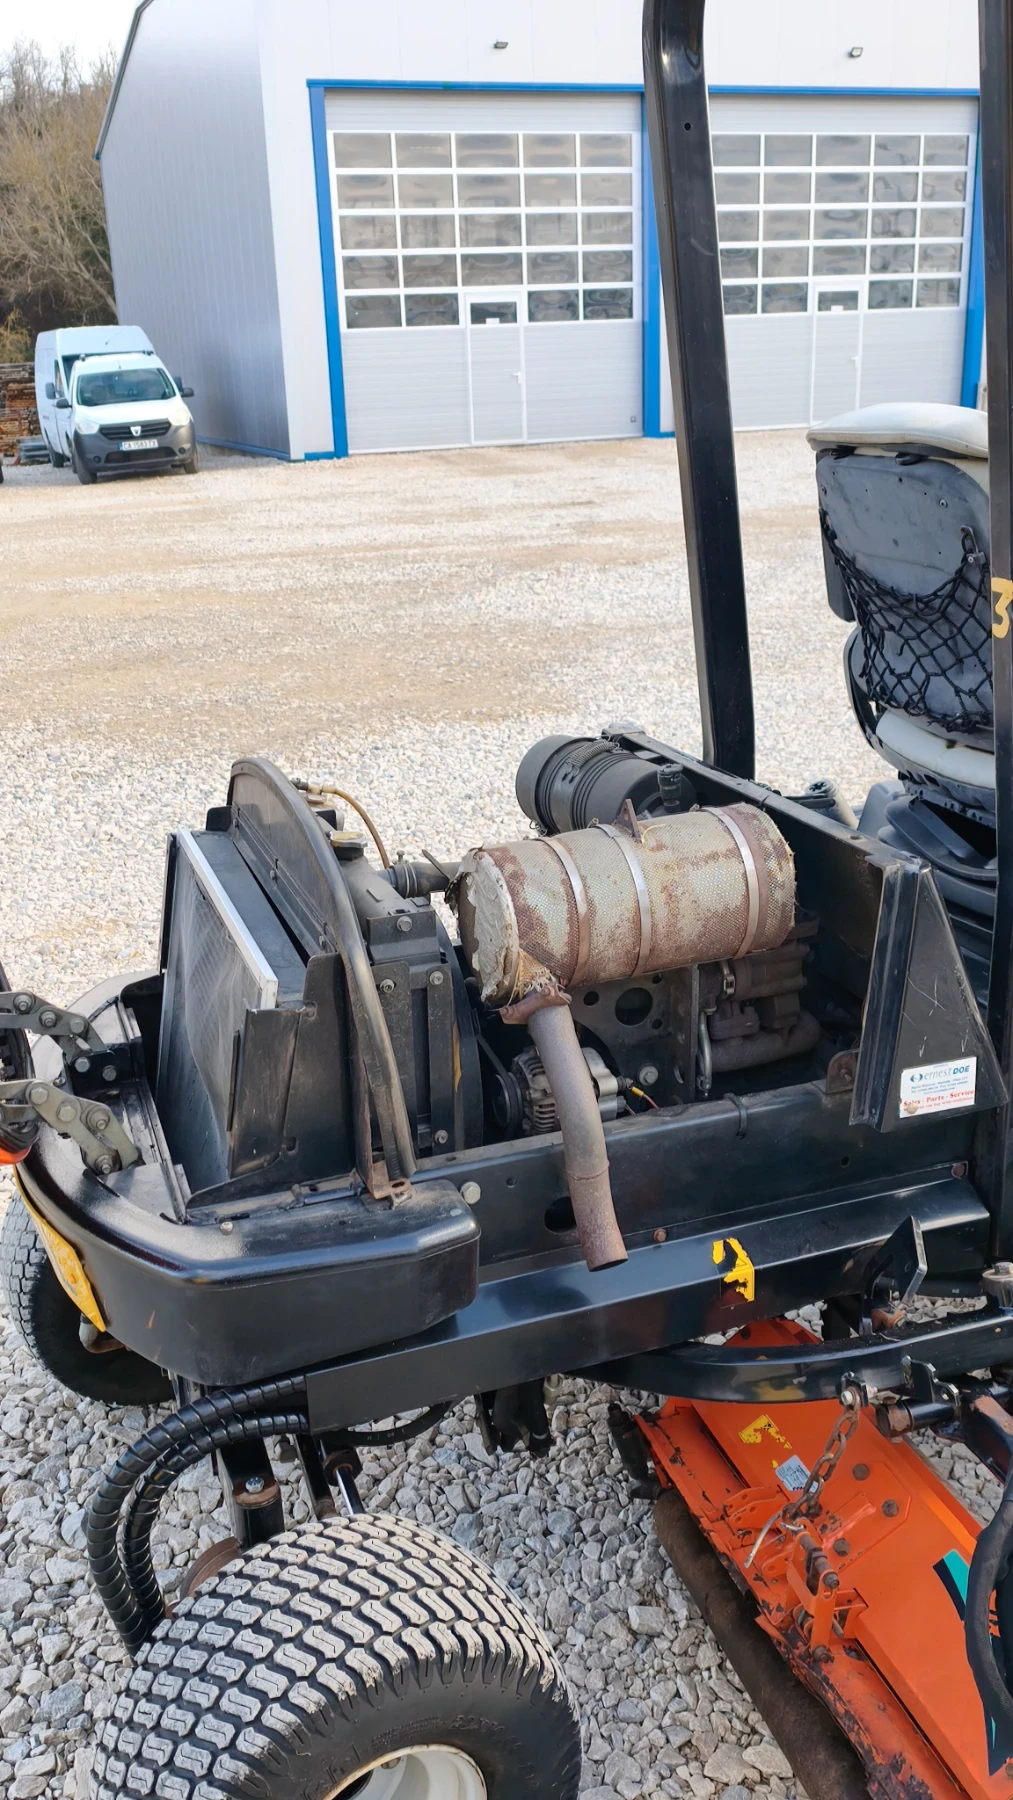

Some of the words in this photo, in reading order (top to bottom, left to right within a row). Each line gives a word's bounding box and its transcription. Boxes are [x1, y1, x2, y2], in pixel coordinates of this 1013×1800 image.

[924, 1067, 952, 1080] ernest
[952, 1065, 970, 1075] DOE
[926, 1095, 944, 1103] Parts
[949, 1090, 974, 1099] Service
